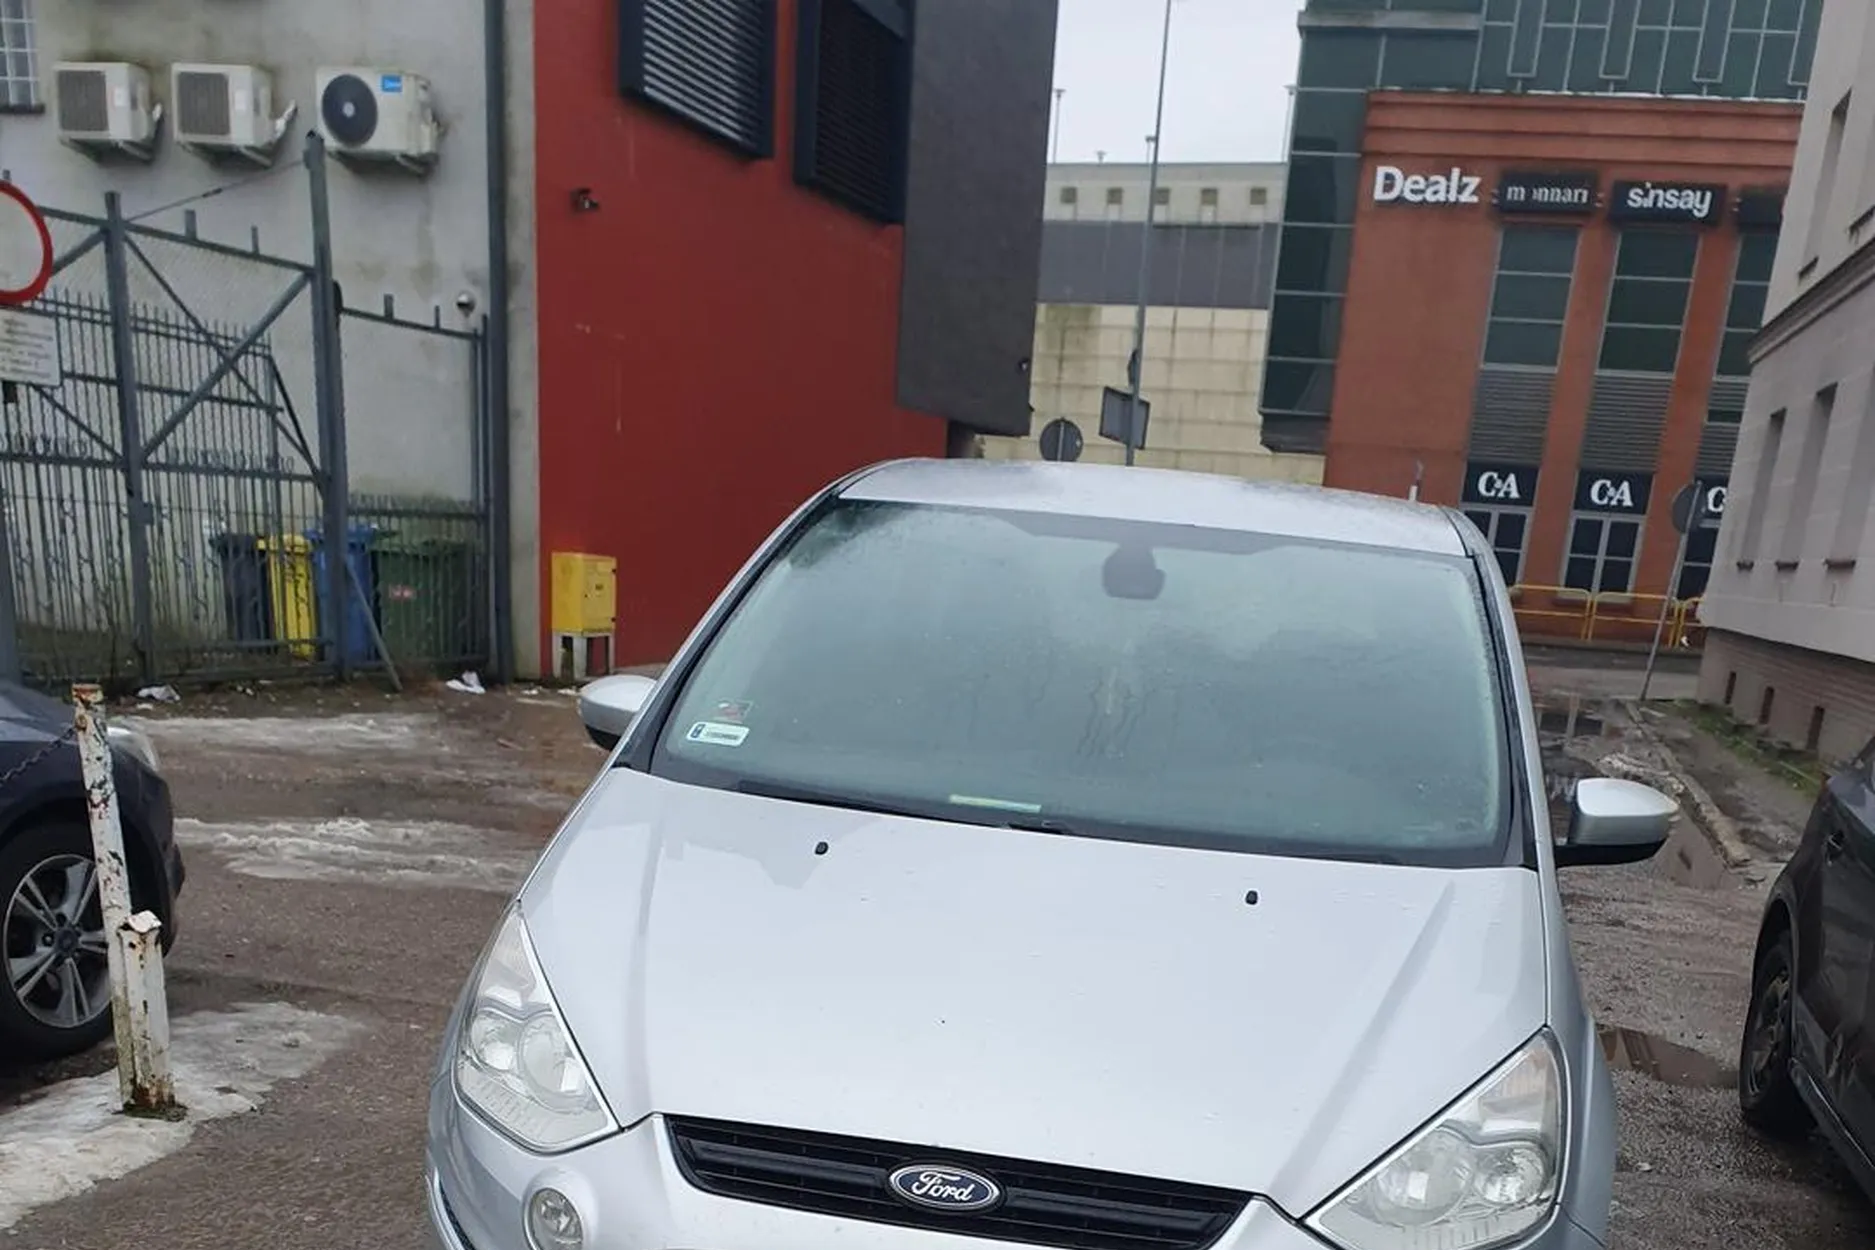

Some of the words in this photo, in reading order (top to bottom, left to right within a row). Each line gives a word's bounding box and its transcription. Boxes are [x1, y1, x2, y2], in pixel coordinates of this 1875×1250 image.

[1373, 165, 1482, 204] Dealz
[1626, 181, 1712, 218] sinsay
[1478, 471, 1520, 499] C&A
[1590, 479, 1634, 507] C&A
[911, 1171, 975, 1201] Ford
